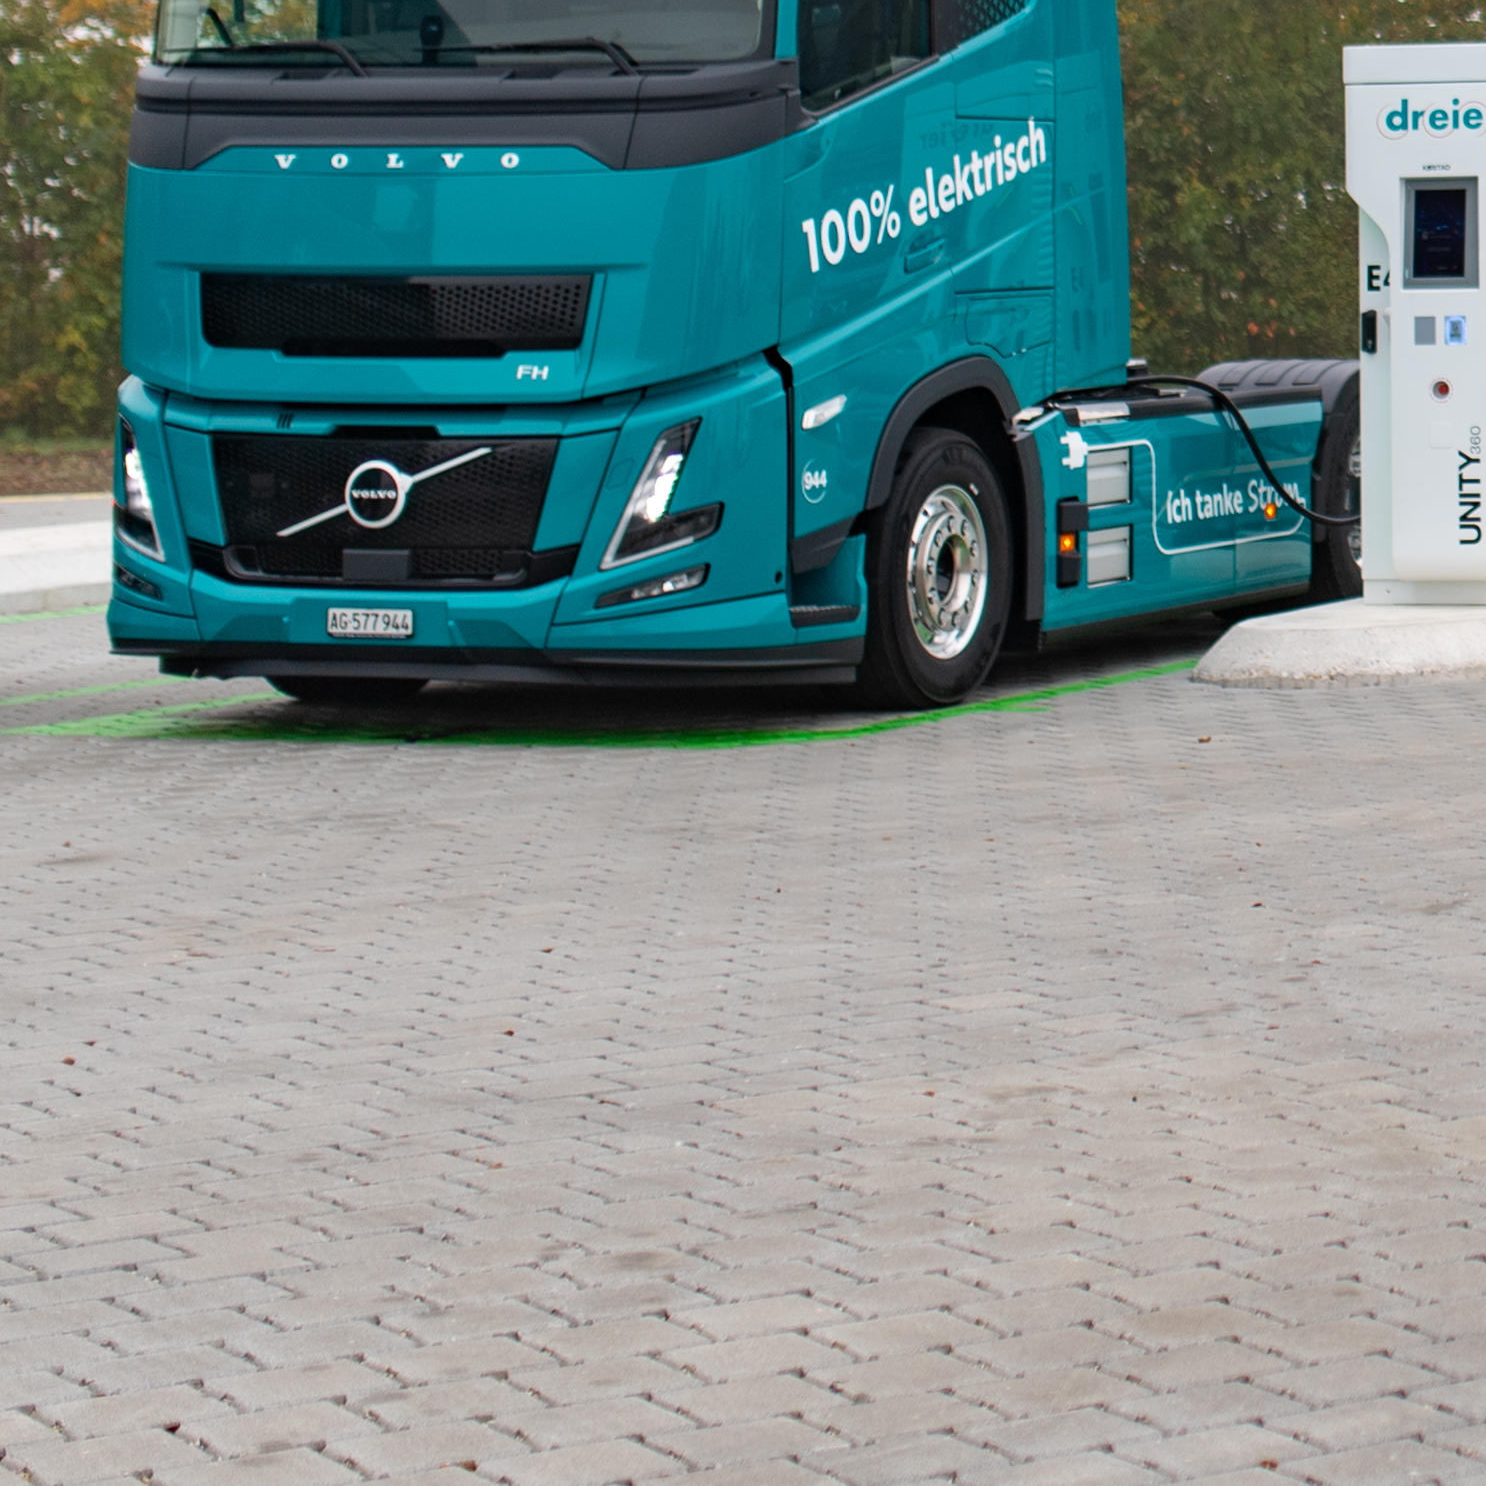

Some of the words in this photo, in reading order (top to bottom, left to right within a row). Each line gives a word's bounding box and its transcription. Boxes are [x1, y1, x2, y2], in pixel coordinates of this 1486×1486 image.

[275, 152, 520, 170] VOLVO
[802, 184, 901, 274] 100%
[909, 116, 1047, 227] elektrisch
[515, 364, 550, 381] FH
[1469, 425, 1482, 455] 360
[803, 469, 828, 491] 944
[350, 489, 397, 500] VOLVO
[1166, 488, 1193, 524] Ich
[1195, 482, 1244, 520] tanke
[1458, 449, 1483, 545] UNITY
